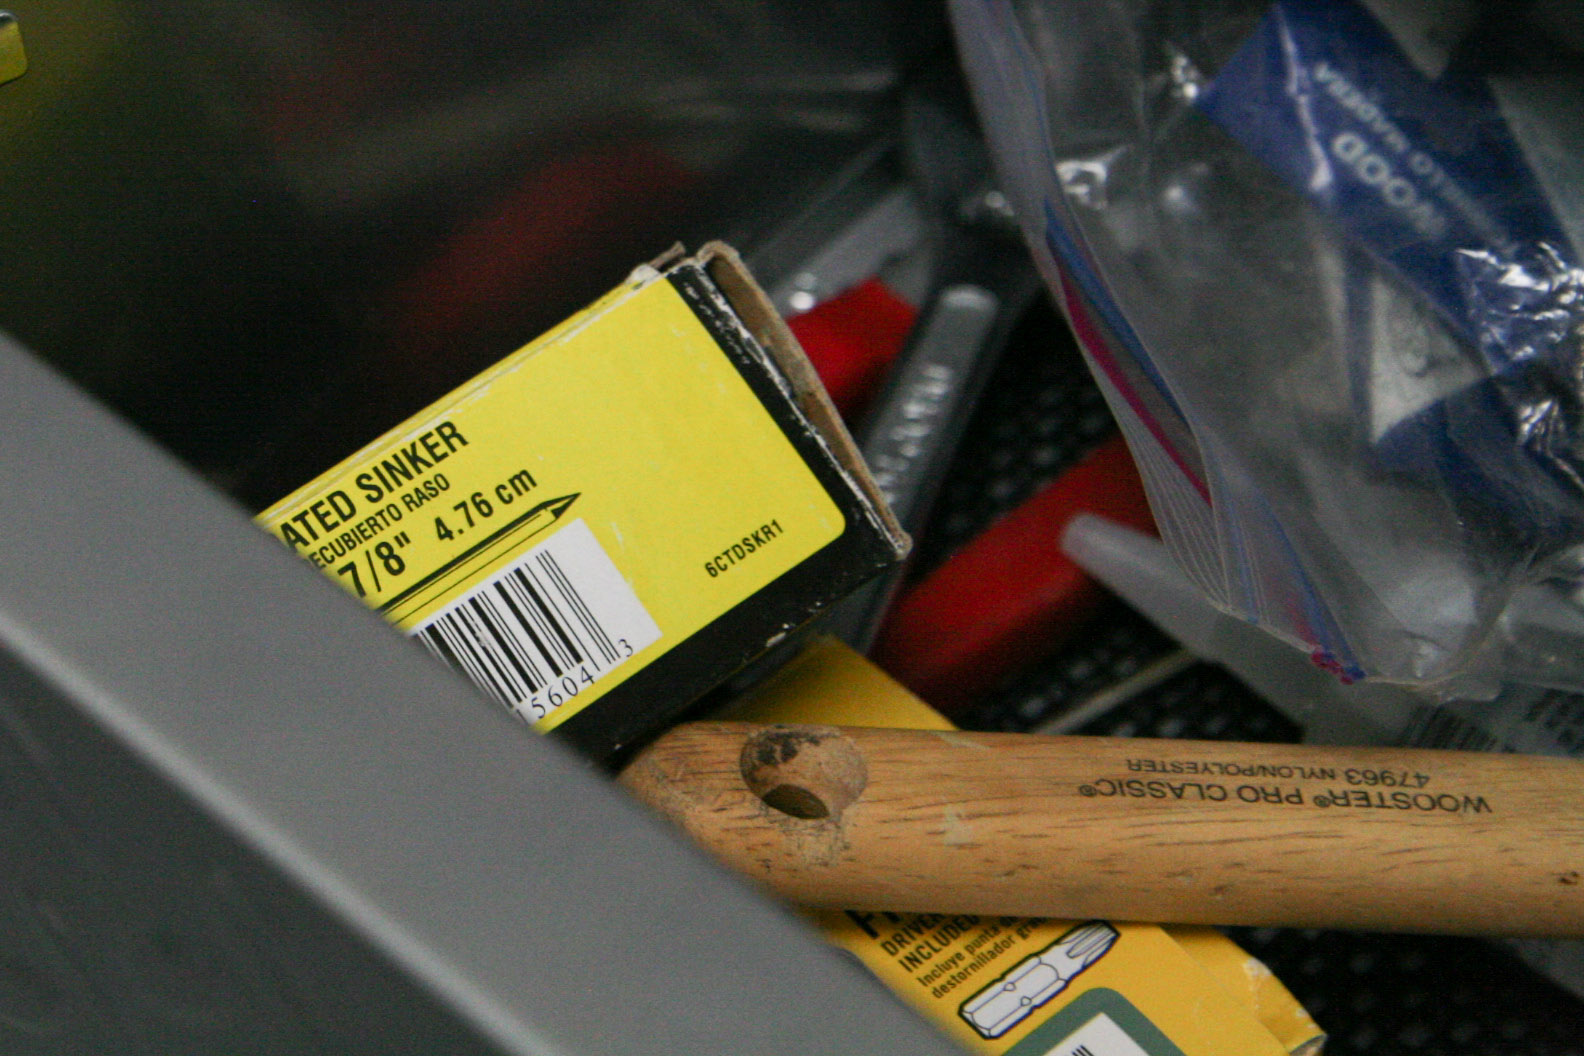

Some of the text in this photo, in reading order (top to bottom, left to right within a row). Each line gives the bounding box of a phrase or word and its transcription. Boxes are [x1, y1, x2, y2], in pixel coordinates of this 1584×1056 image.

[280, 420, 469, 548] ATED SINKER
[401, 473, 451, 513] RASO
[434, 491, 494, 542] 4.76
[494, 468, 538, 505] cm
[704, 518, 783, 578] 6CTDSKR1
[617, 638, 634, 658] 3
[1126, 759, 1430, 788] 47963 NYLON/POLYESTER
[1236, 785, 1304, 805] PRO
[917, 951, 965, 987] Incluye
[964, 924, 1002, 957] punta
[932, 934, 1016, 999] destornillador
